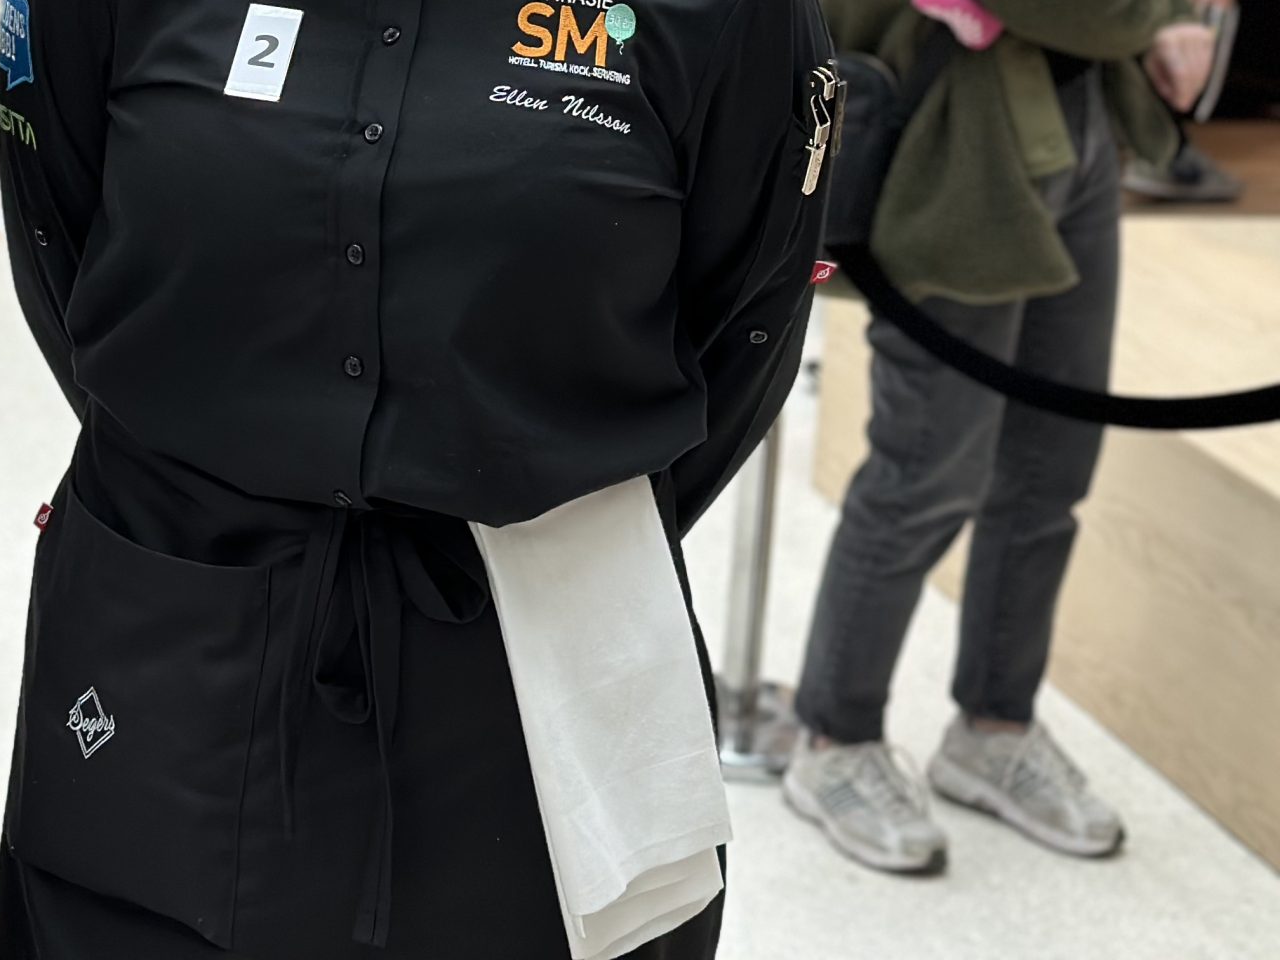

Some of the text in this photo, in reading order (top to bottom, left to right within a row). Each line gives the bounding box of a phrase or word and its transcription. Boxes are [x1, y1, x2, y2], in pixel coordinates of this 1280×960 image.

[247, 34, 280, 69] 2
[511, 1, 608, 68] SM
[489, 85, 631, 135] Ellen Nilsson
[66, 702, 116, 742] Segers
